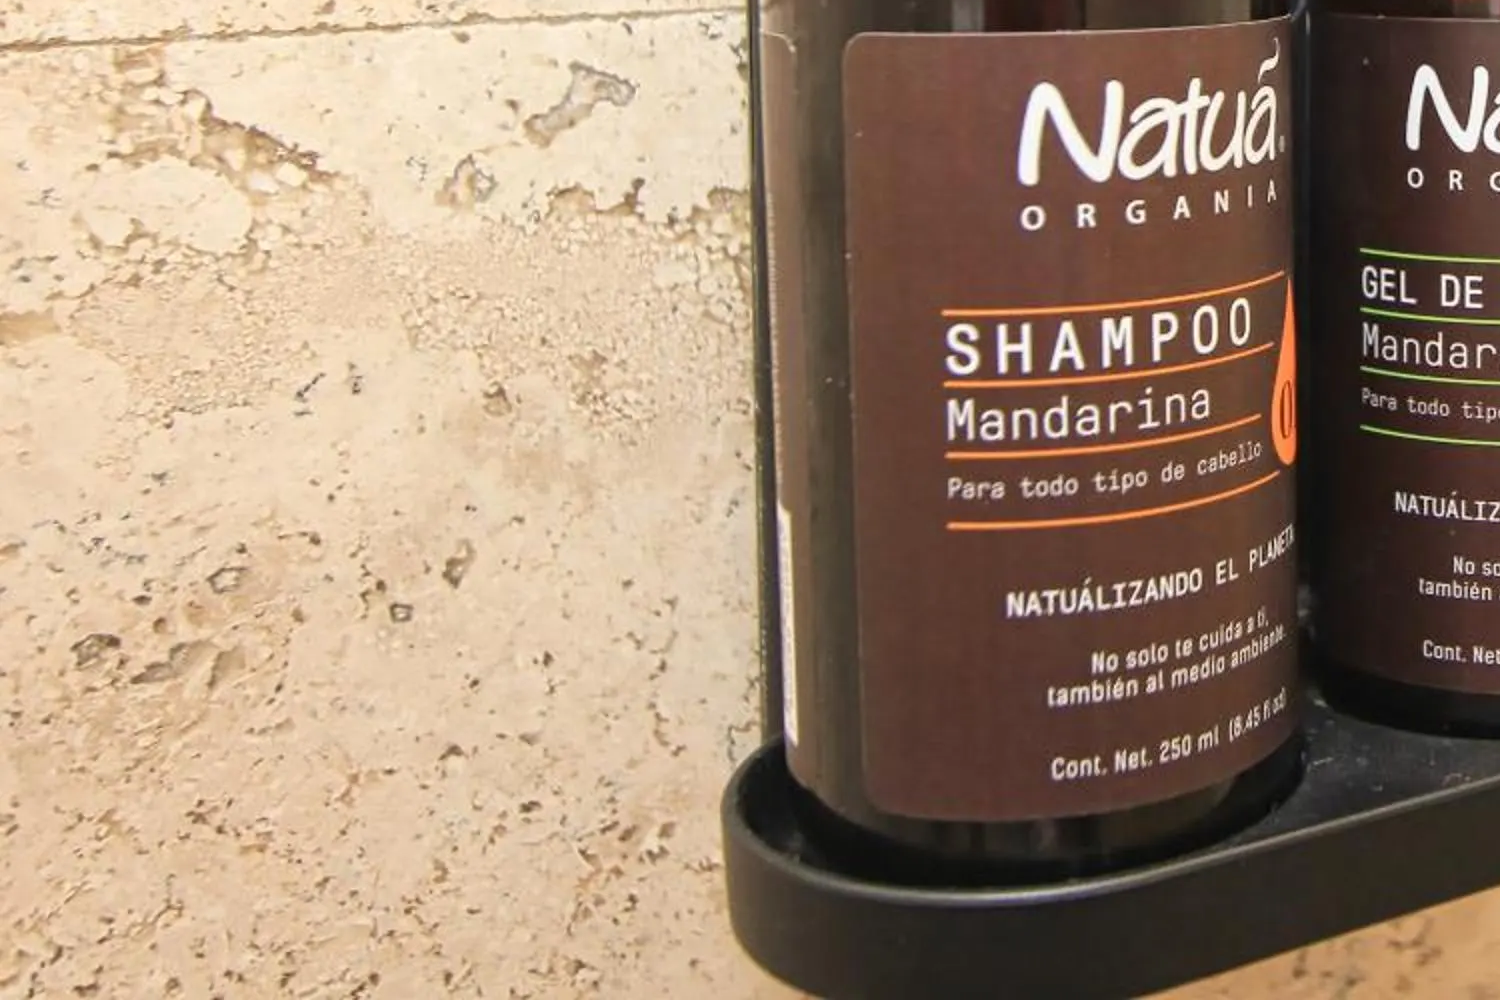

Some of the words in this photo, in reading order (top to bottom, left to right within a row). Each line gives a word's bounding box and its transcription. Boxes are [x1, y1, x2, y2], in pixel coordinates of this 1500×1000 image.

[1020, 179, 1277, 231] ORGANIA
[1361, 265, 1417, 305] GEL
[1440, 274, 1484, 309] DE
[944, 297, 1252, 376] SHAMPOO
[947, 386, 1211, 442] Mandarina
[1361, 387, 1397, 411] Para
[1407, 398, 1450, 417] todo
[947, 476, 1005, 500] Para
[1020, 475, 1079, 498] todo
[1093, 468, 1148, 496] tipo
[1160, 461, 1185, 483] de
[1197, 440, 1262, 476] cabello
[1006, 567, 1203, 618] NATUÁLIZANDO
[1215, 557, 1239, 586] EL
[1419, 577, 1492, 601] también
[1453, 555, 1475, 576] No
[1091, 651, 1119, 675] No
[1126, 643, 1169, 670] solo
[1175, 638, 1193, 659] te
[1199, 622, 1243, 652] cuida
[1247, 616, 1255, 634] a
[1423, 639, 1467, 663] Cont.
[1047, 677, 1139, 708] también
[1146, 675, 1164, 694] al
[1171, 655, 1226, 689] medio
[1051, 757, 1107, 782] Cont.
[1114, 747, 1153, 773] Net.
[1159, 734, 1191, 765] 250
[1198, 724, 1219, 752] ml
